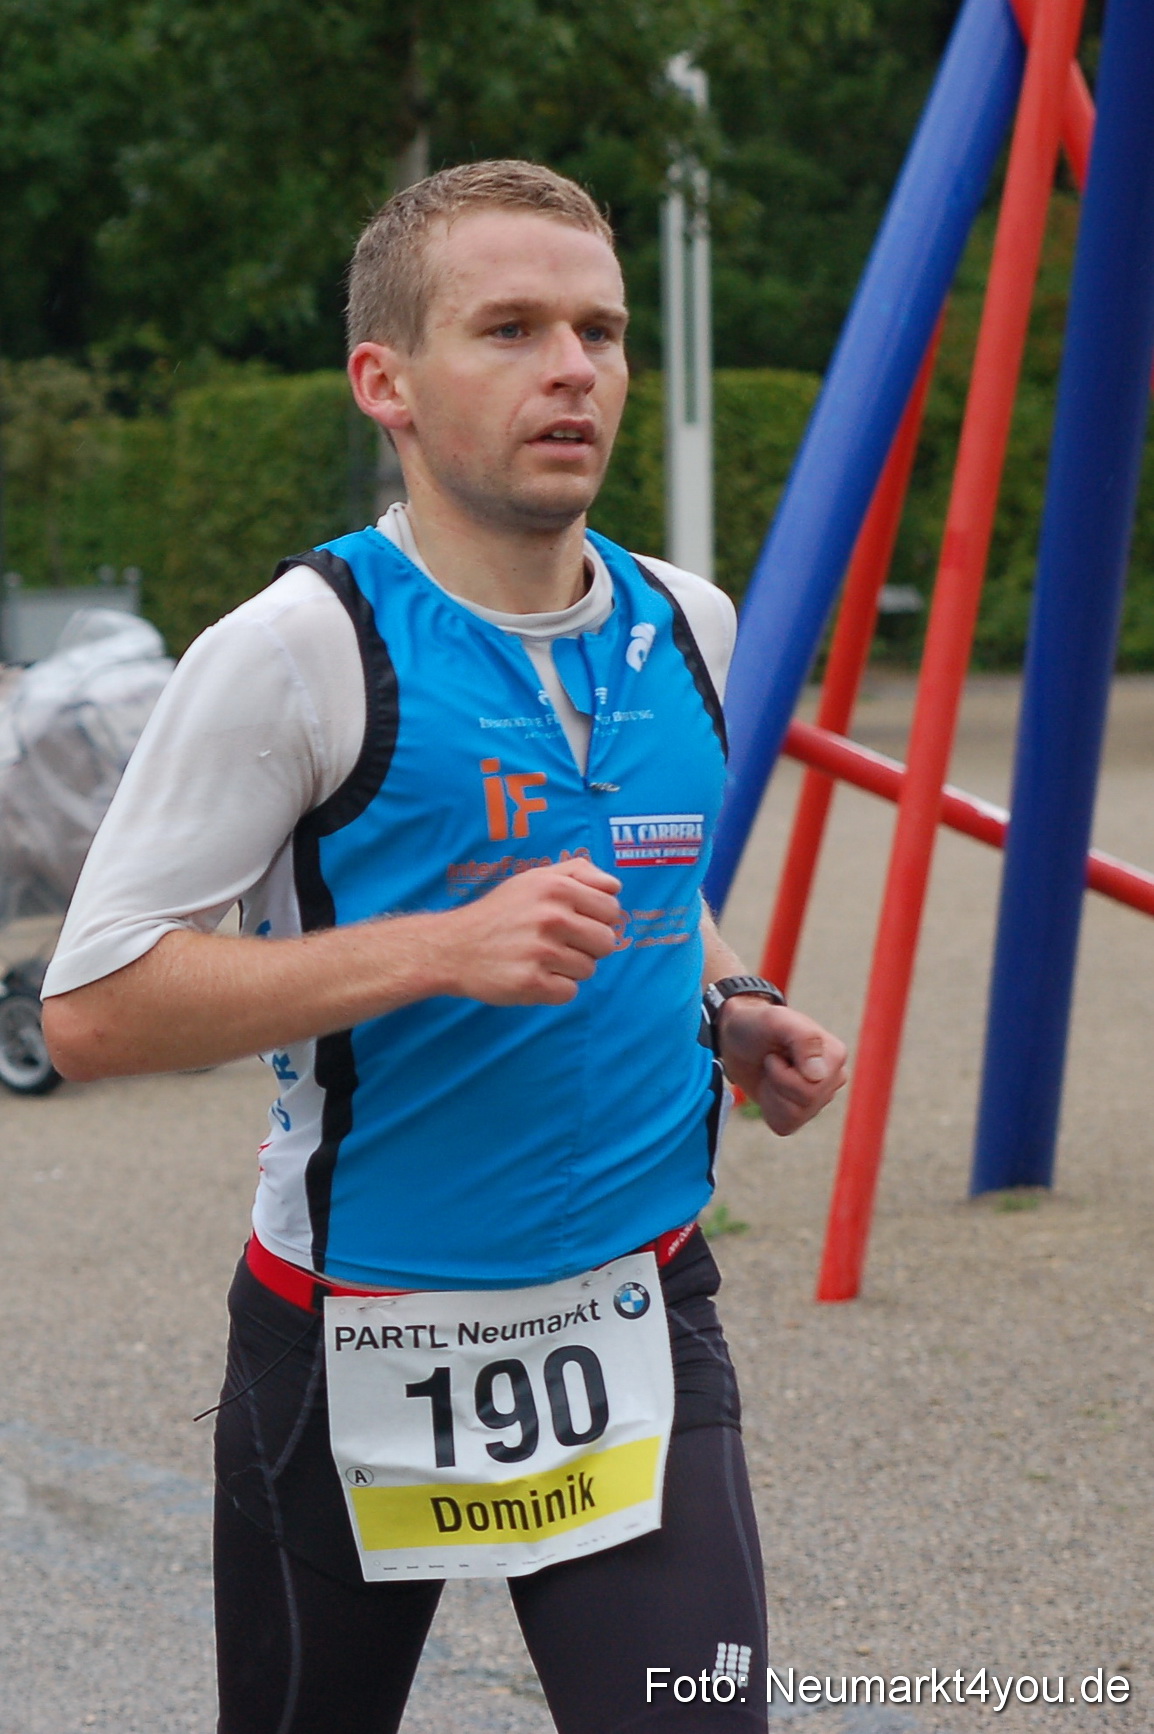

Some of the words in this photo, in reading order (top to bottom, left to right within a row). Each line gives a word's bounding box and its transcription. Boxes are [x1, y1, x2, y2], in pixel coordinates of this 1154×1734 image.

[611, 825, 634, 843] LA
[335, 1325, 448, 1351] PARTL
[458, 1298, 601, 1346] Neumarkt
[405, 1344, 609, 1469] 190
[355, 1469, 367, 1483] A
[430, 1471, 597, 1533] Dominik
